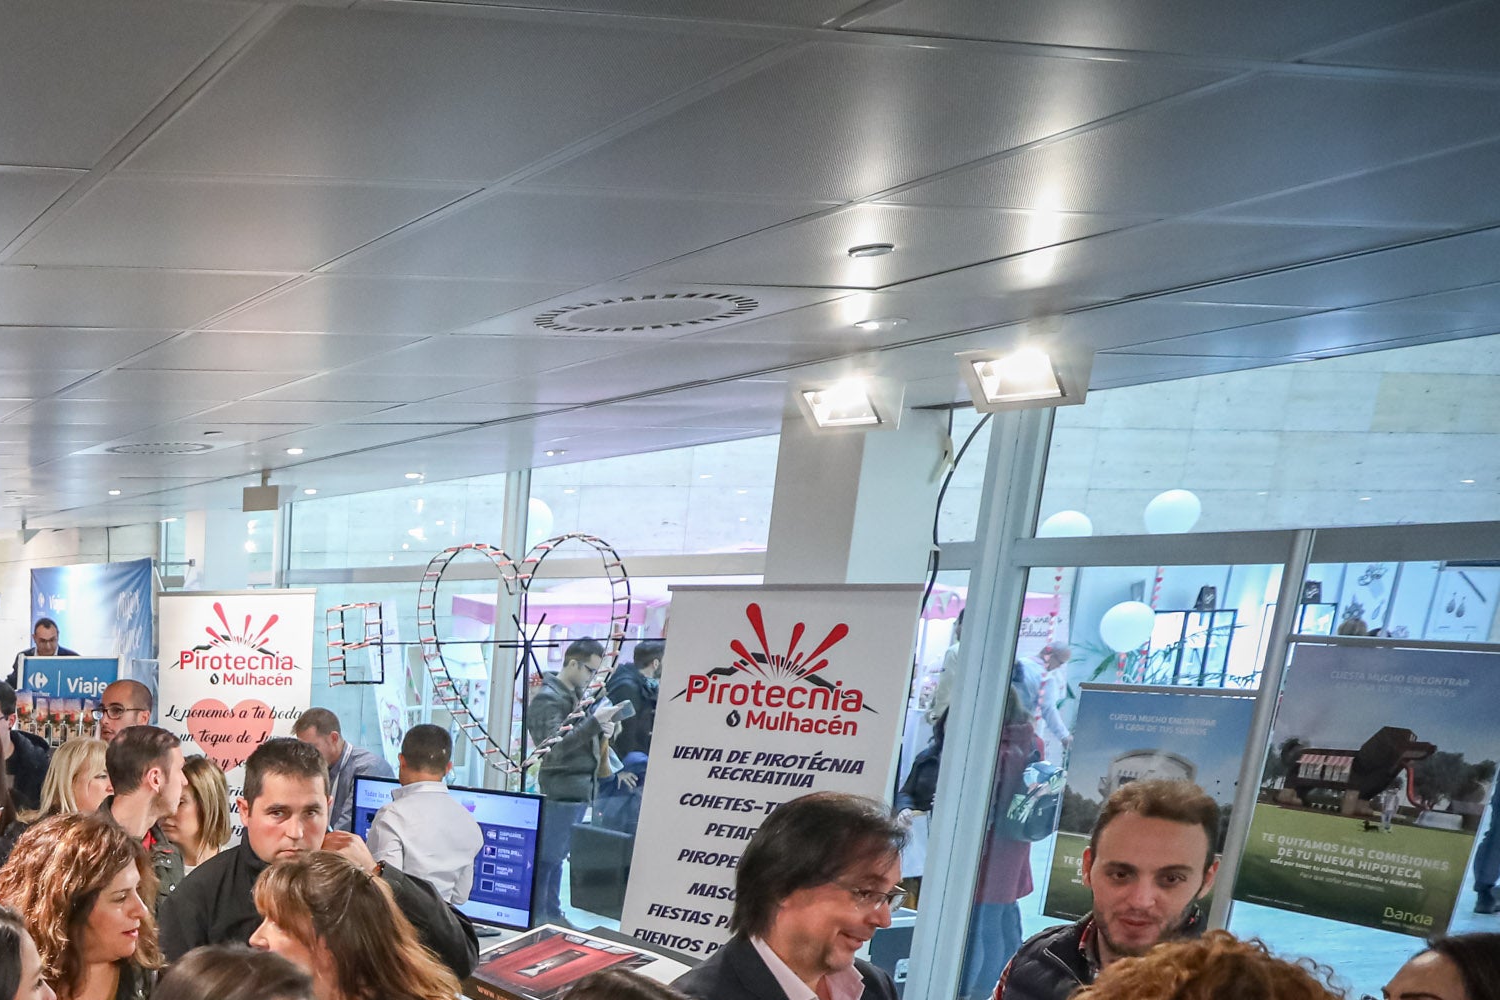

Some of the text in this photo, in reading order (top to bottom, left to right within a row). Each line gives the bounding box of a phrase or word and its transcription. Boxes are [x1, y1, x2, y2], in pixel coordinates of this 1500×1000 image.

[179, 650, 294, 671] Pirotecnia
[67, 677, 107, 698] Viaje
[223, 672, 293, 686] Mulhacén
[685, 674, 864, 714] Pirotecnia
[165, 705, 302, 722] Le ponemos a tu boda
[745, 710, 858, 736] Mulhacén
[180, 733, 195, 742] un
[199, 729, 233, 747] toque
[236, 730, 252, 744] de
[672, 745, 865, 776] VENTA DE PIROTÉCNIA
[707, 766, 815, 789] RECREATIVA
[1261, 832, 1450, 872] TE QUITAMOS LAS COMISIONES
[1277, 847, 1422, 880] DE TU NUEVA HIPOTECA
[647, 903, 713, 927] FIESTAS
[1383, 906, 1433, 926] Bankia
[633, 928, 703, 954] EVENTOS
